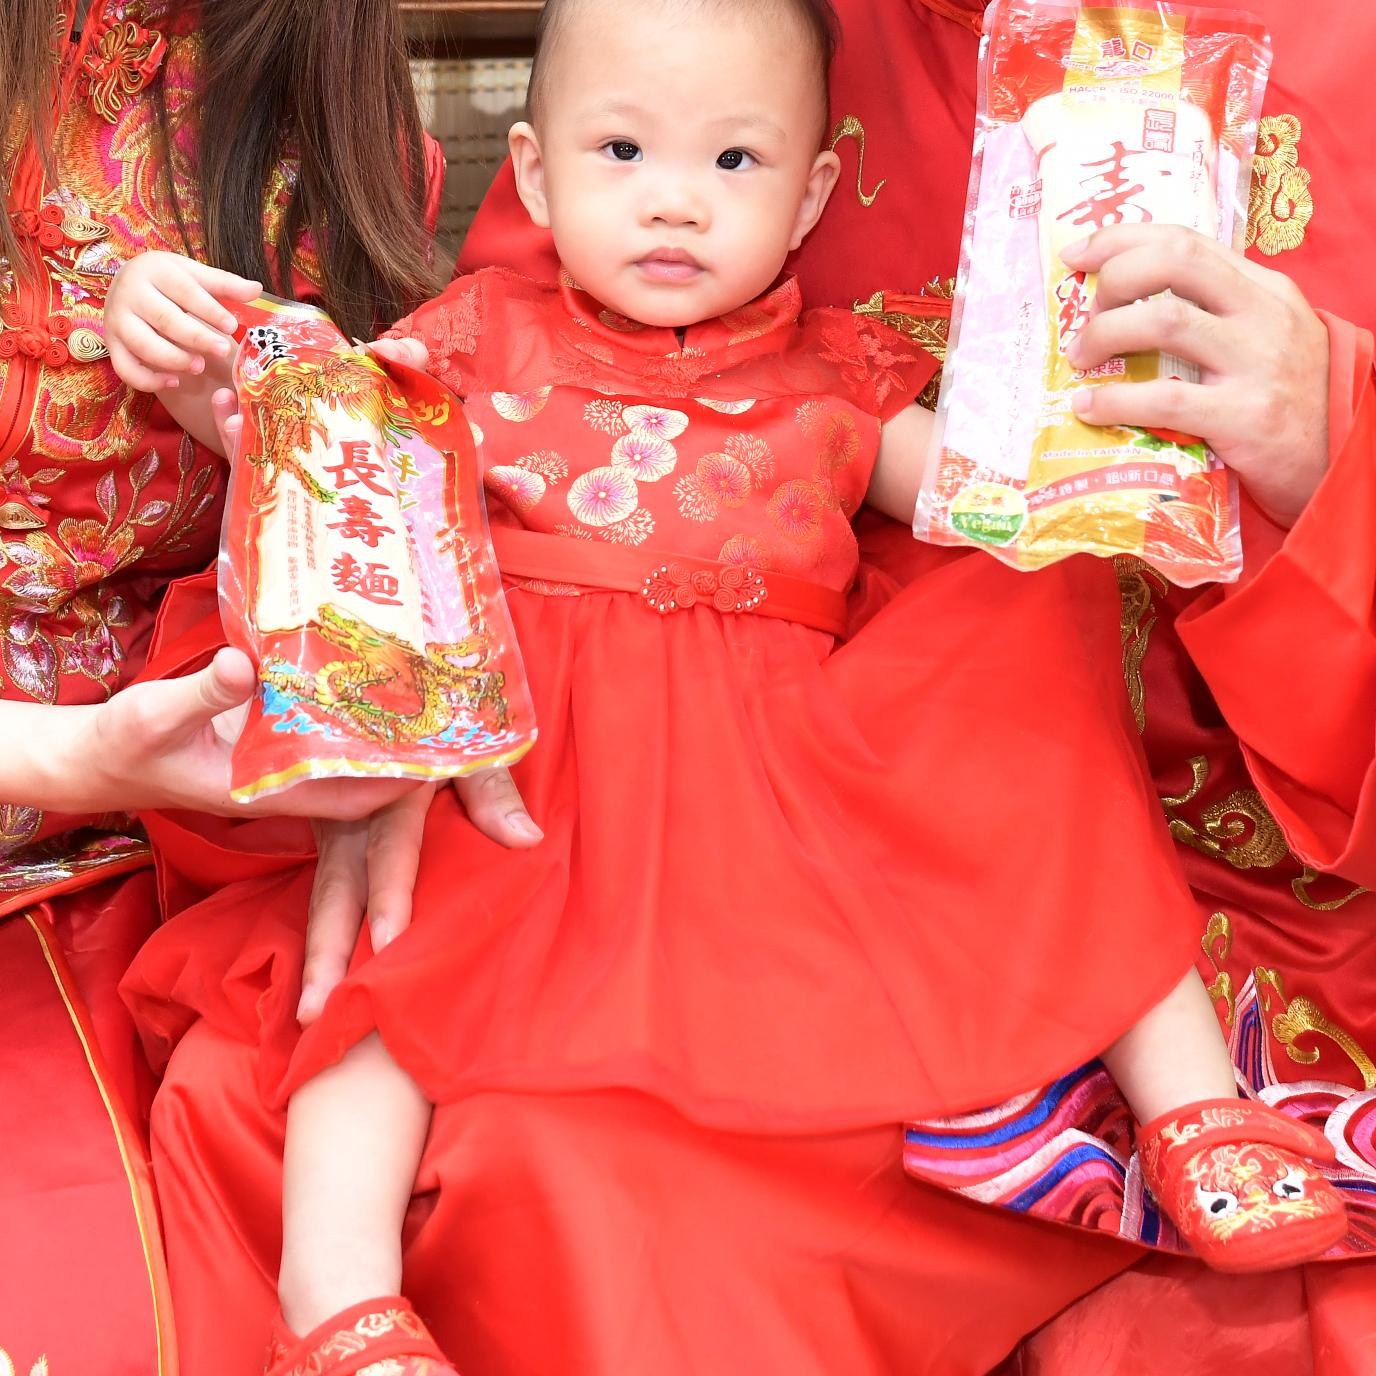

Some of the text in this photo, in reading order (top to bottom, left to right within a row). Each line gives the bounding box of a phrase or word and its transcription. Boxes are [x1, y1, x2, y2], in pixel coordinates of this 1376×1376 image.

[1101, 38, 1154, 61] 龍口
[1042, 451, 1073, 459] Made
[1093, 447, 1142, 456] TAIWAN
[323, 439, 403, 607] 長壽麵
[960, 514, 1015, 533] Vegan
